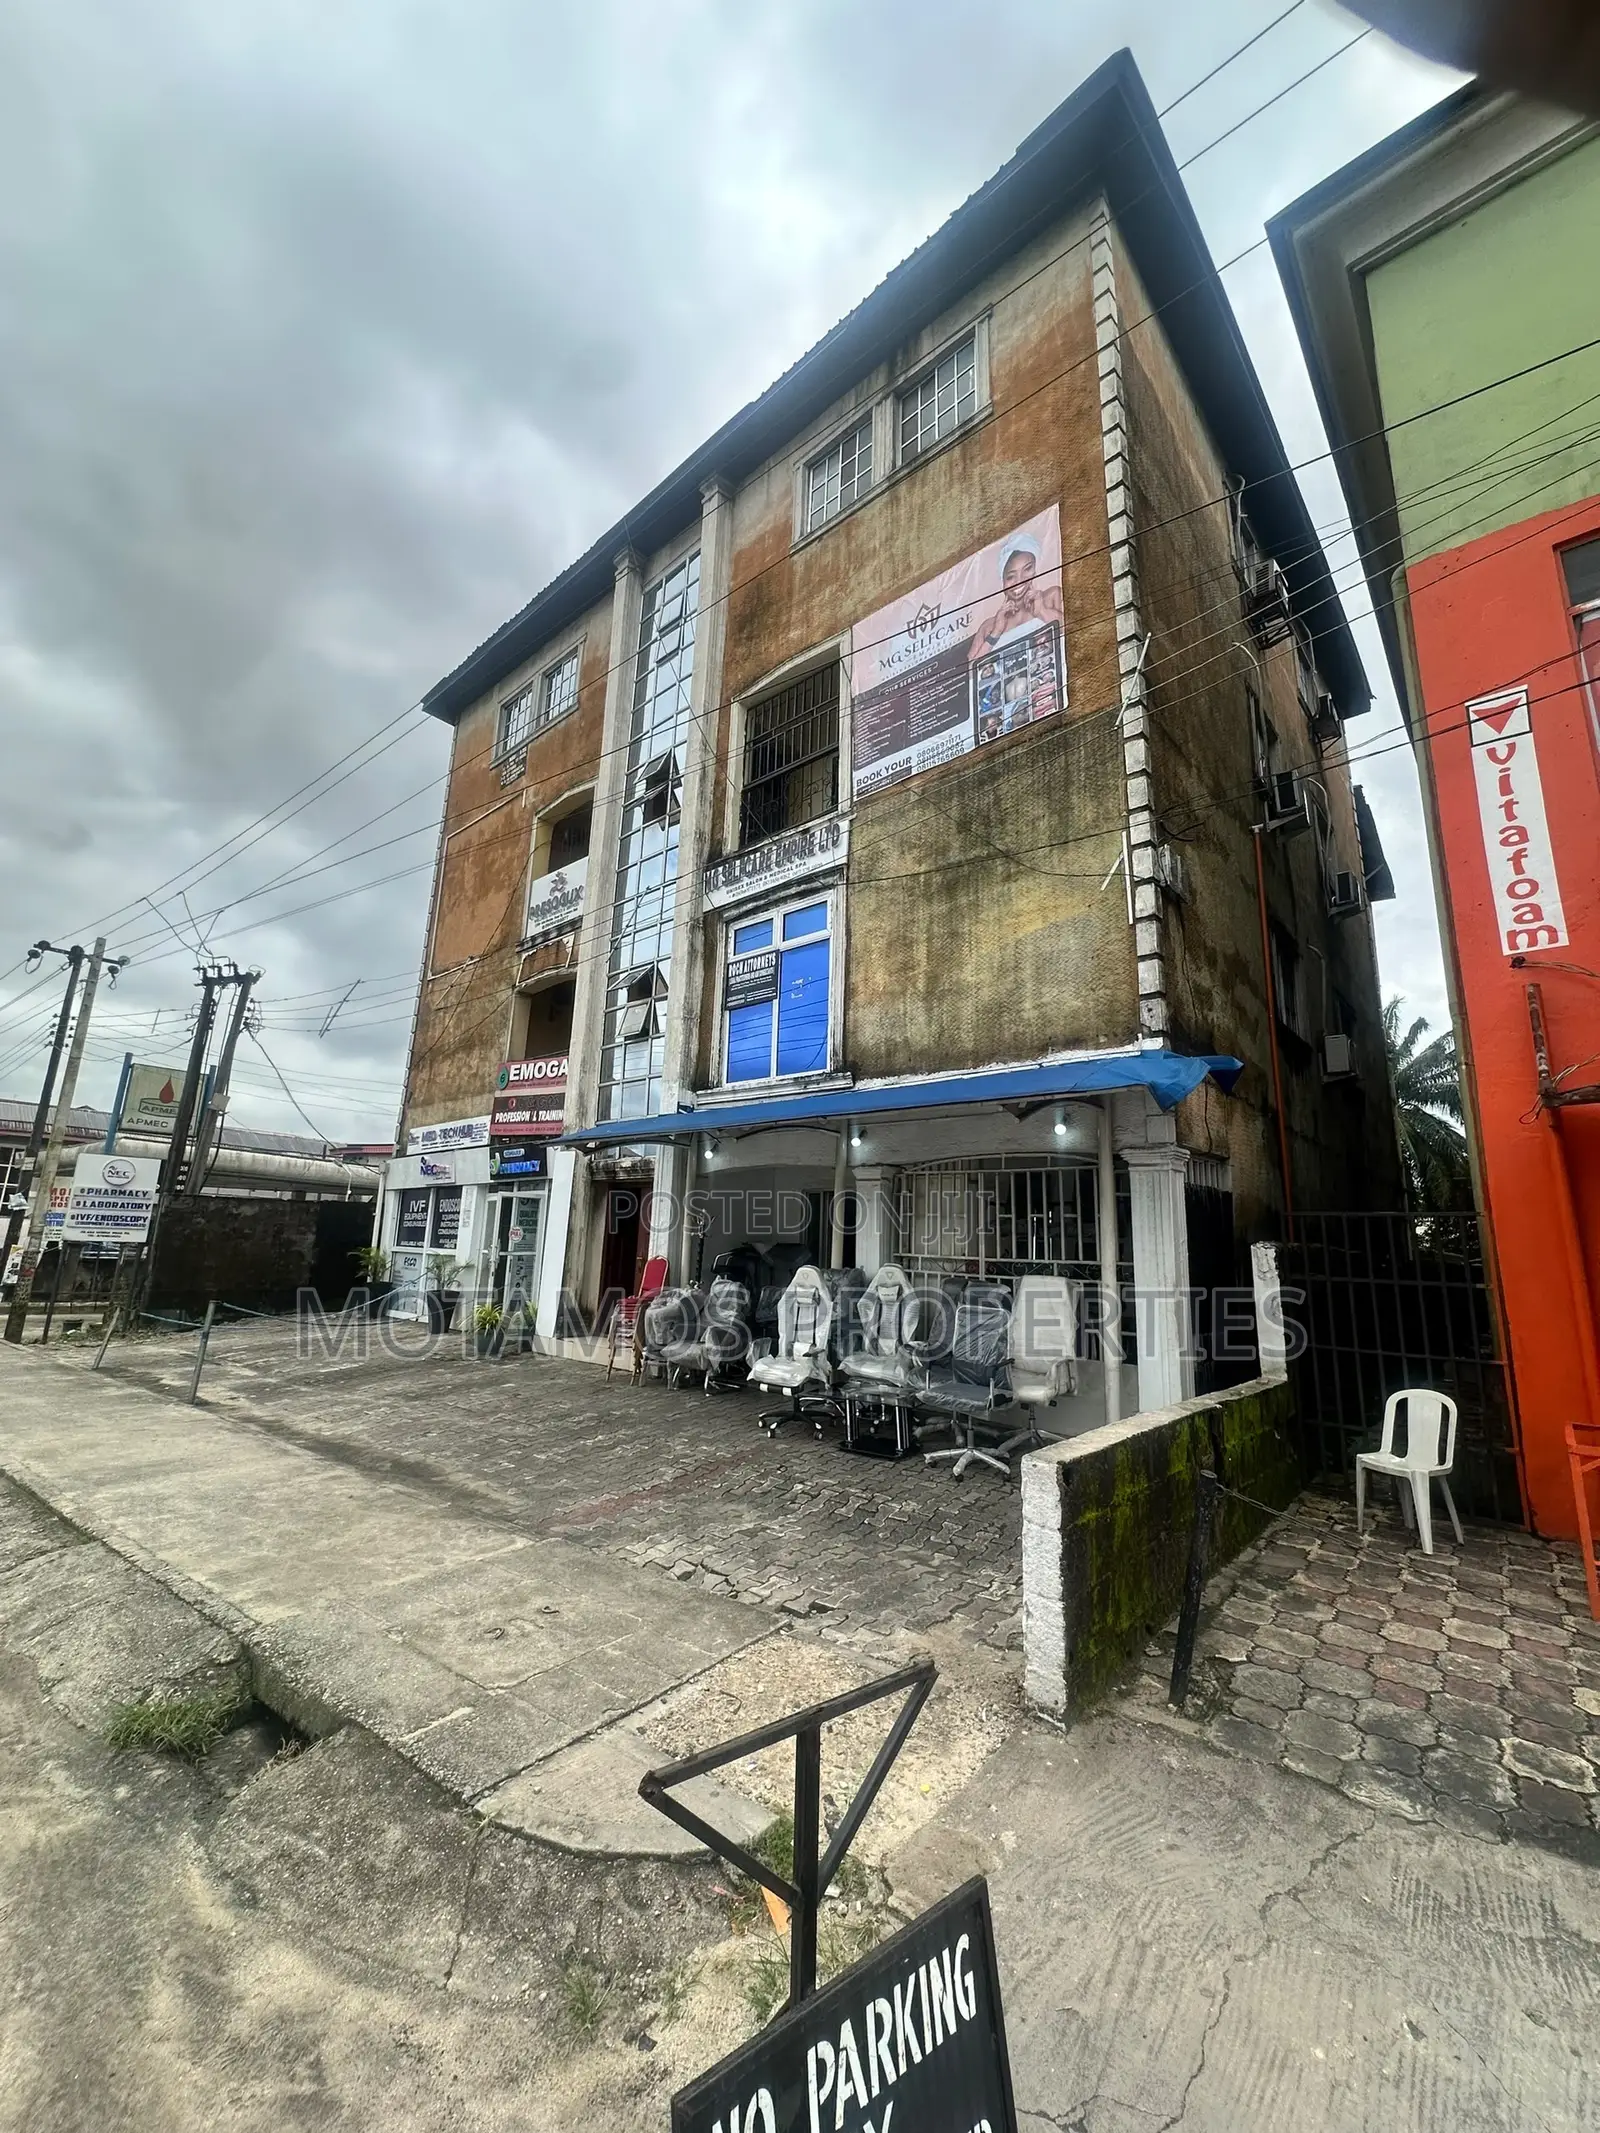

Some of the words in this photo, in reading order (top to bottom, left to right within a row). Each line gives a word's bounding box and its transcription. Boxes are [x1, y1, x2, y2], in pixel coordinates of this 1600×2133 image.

[878, 651, 902, 671] MG
[903, 611, 973, 657] SELFCARE
[899, 667, 932, 687] SERVICES
[856, 769, 883, 788] BOOK
[884, 756, 912, 774] YOUR
[818, 823, 840, 852] LTD
[1486, 742, 1559, 951] vitafoam
[744, 952, 776, 974] ATTORNEYS
[141, 1106, 178, 1114] APME
[127, 1117, 169, 1128] APMEC
[86, 1187, 149, 1198] PHARMACY
[82, 1200, 152, 1210] LABORATORY
[409, 1199, 426, 1213] IVF
[76, 1213, 149, 1223] IVF/ENDOSCOPY
[806, 1933, 978, 2133] PARKING
